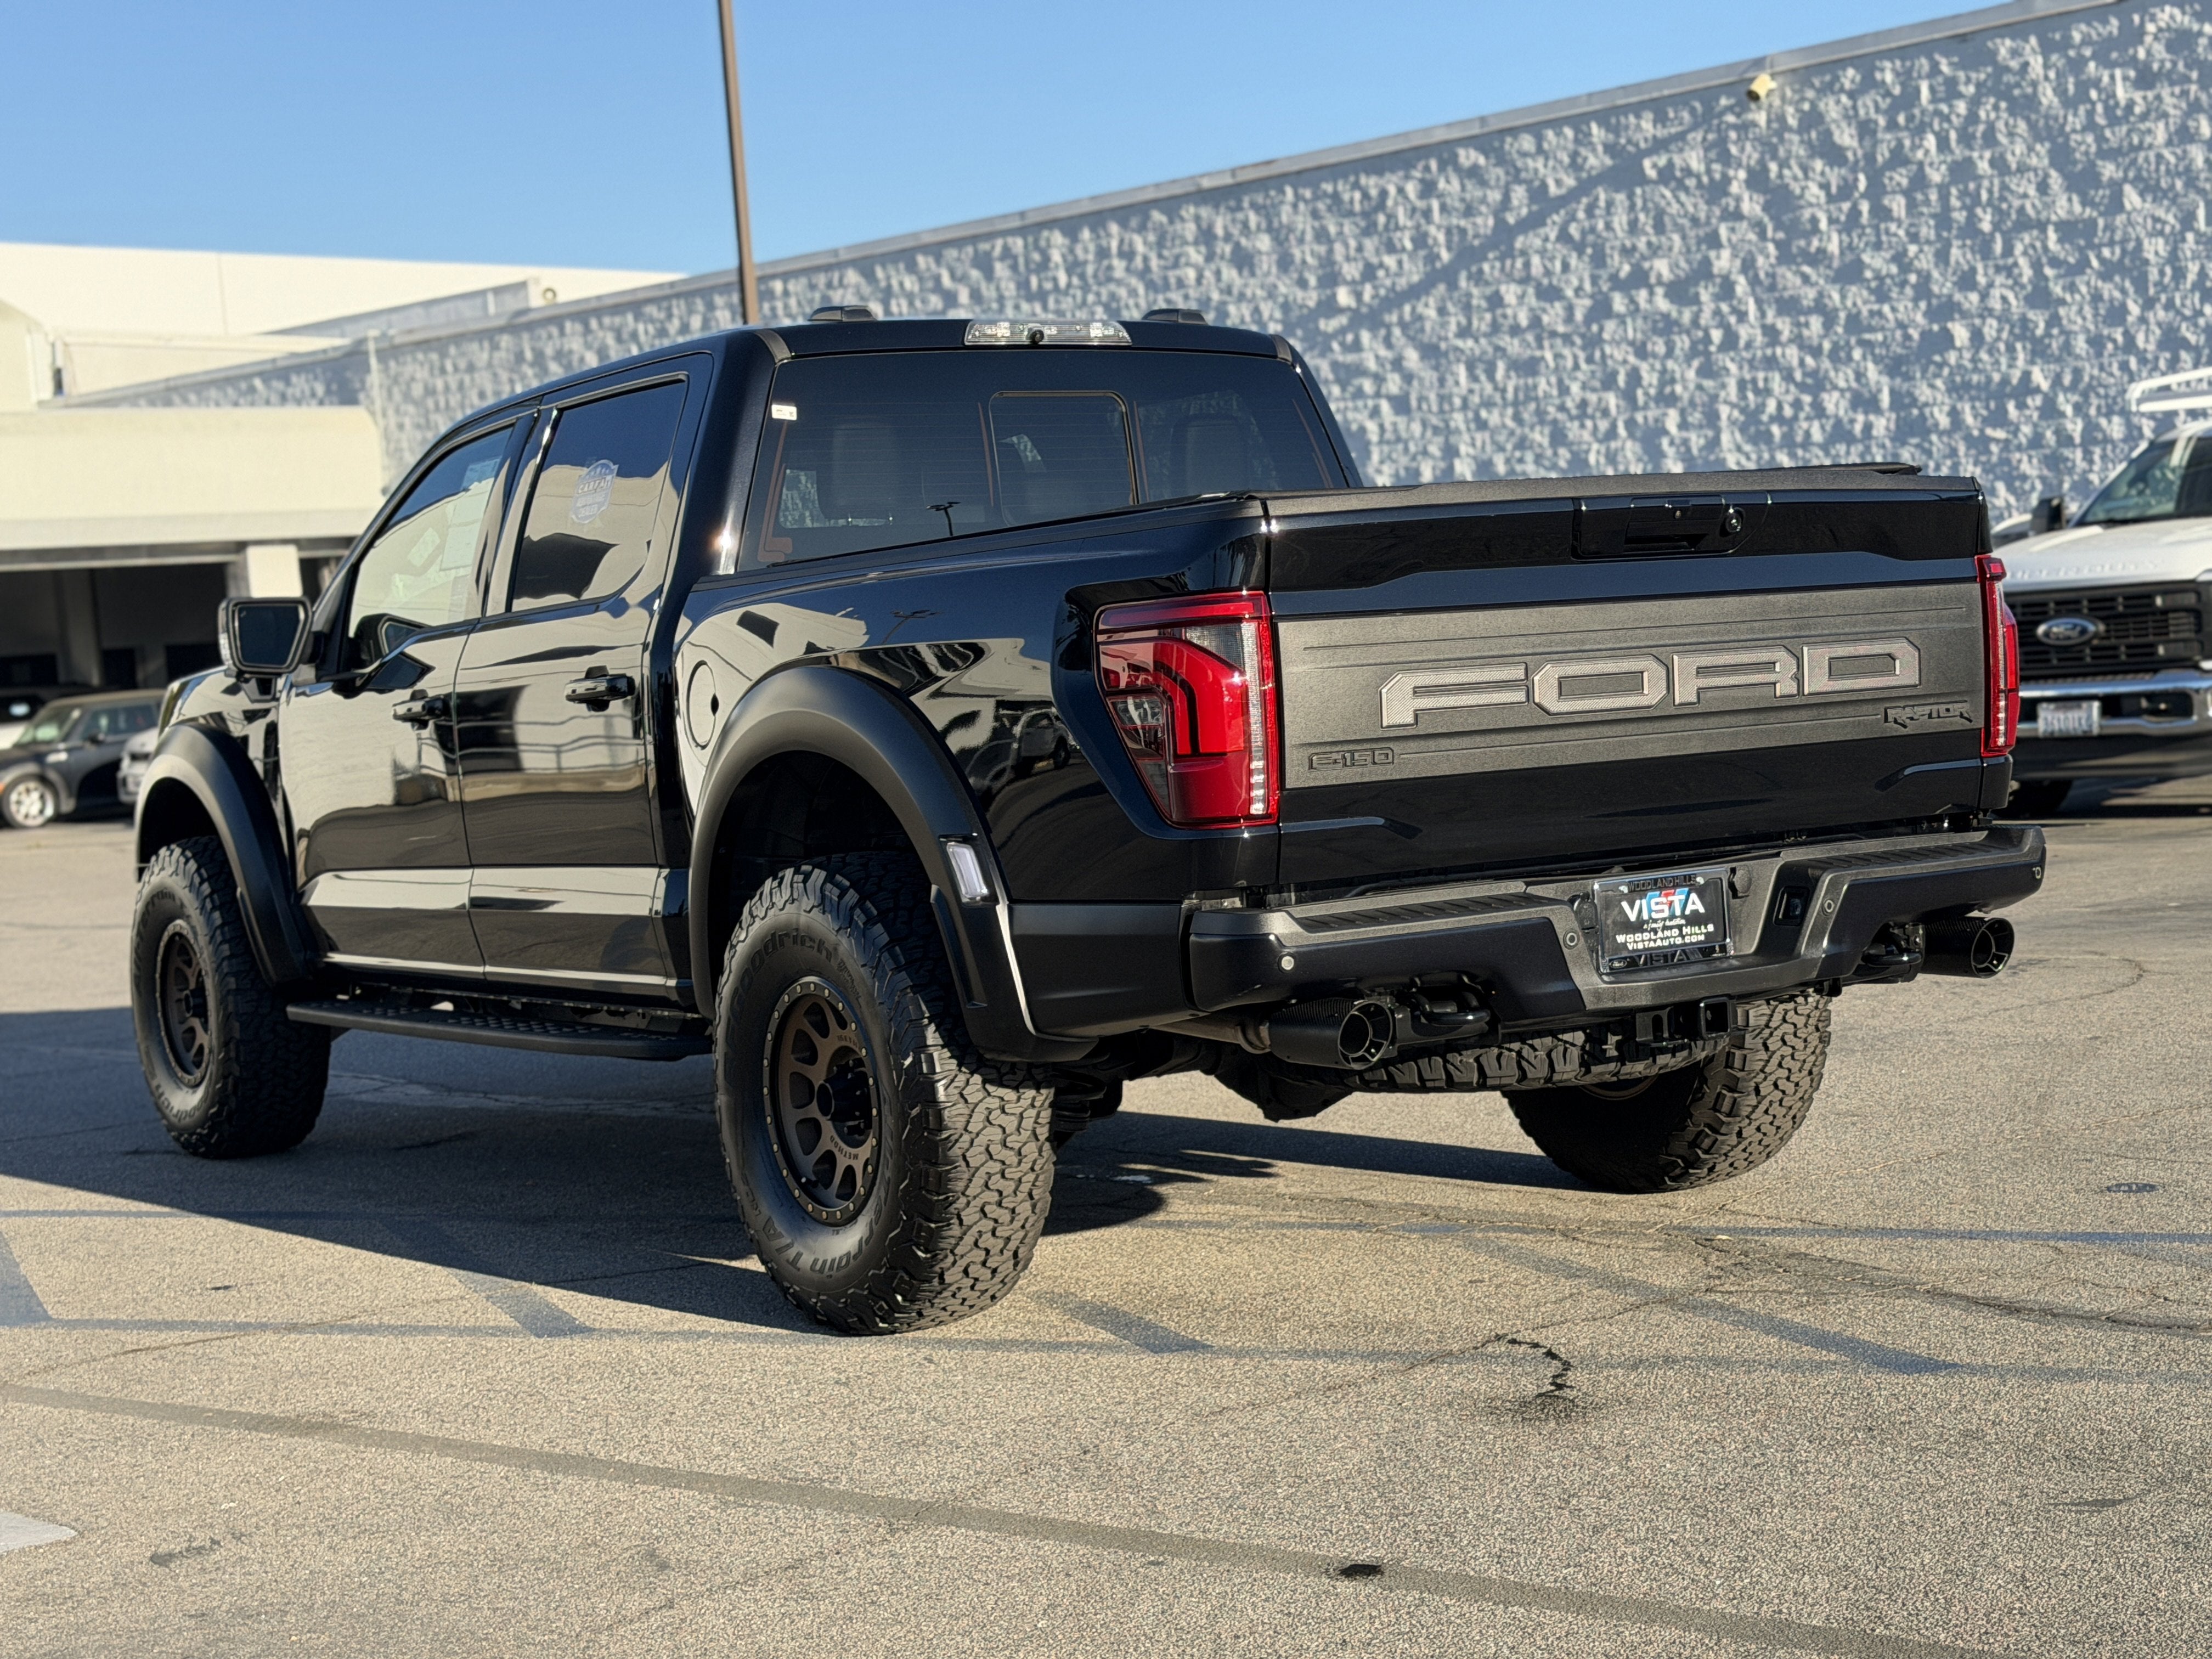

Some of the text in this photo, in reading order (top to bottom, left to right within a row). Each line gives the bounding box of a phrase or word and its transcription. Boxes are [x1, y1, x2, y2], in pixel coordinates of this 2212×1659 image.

[1379, 637, 1921, 730] FORD
[1884, 700, 1973, 729] RAPTOR
[1308, 747, 1394, 771] F-150
[1627, 874, 1696, 892] WOODLAND HILLS
[1621, 893, 1706, 922] VISTA
[1616, 924, 1714, 944] WOODLAND HILLS
[1634, 950, 1688, 967] VISTA
[830, 1135, 859, 1161] METHOD
[763, 1216, 804, 1271] T/A
